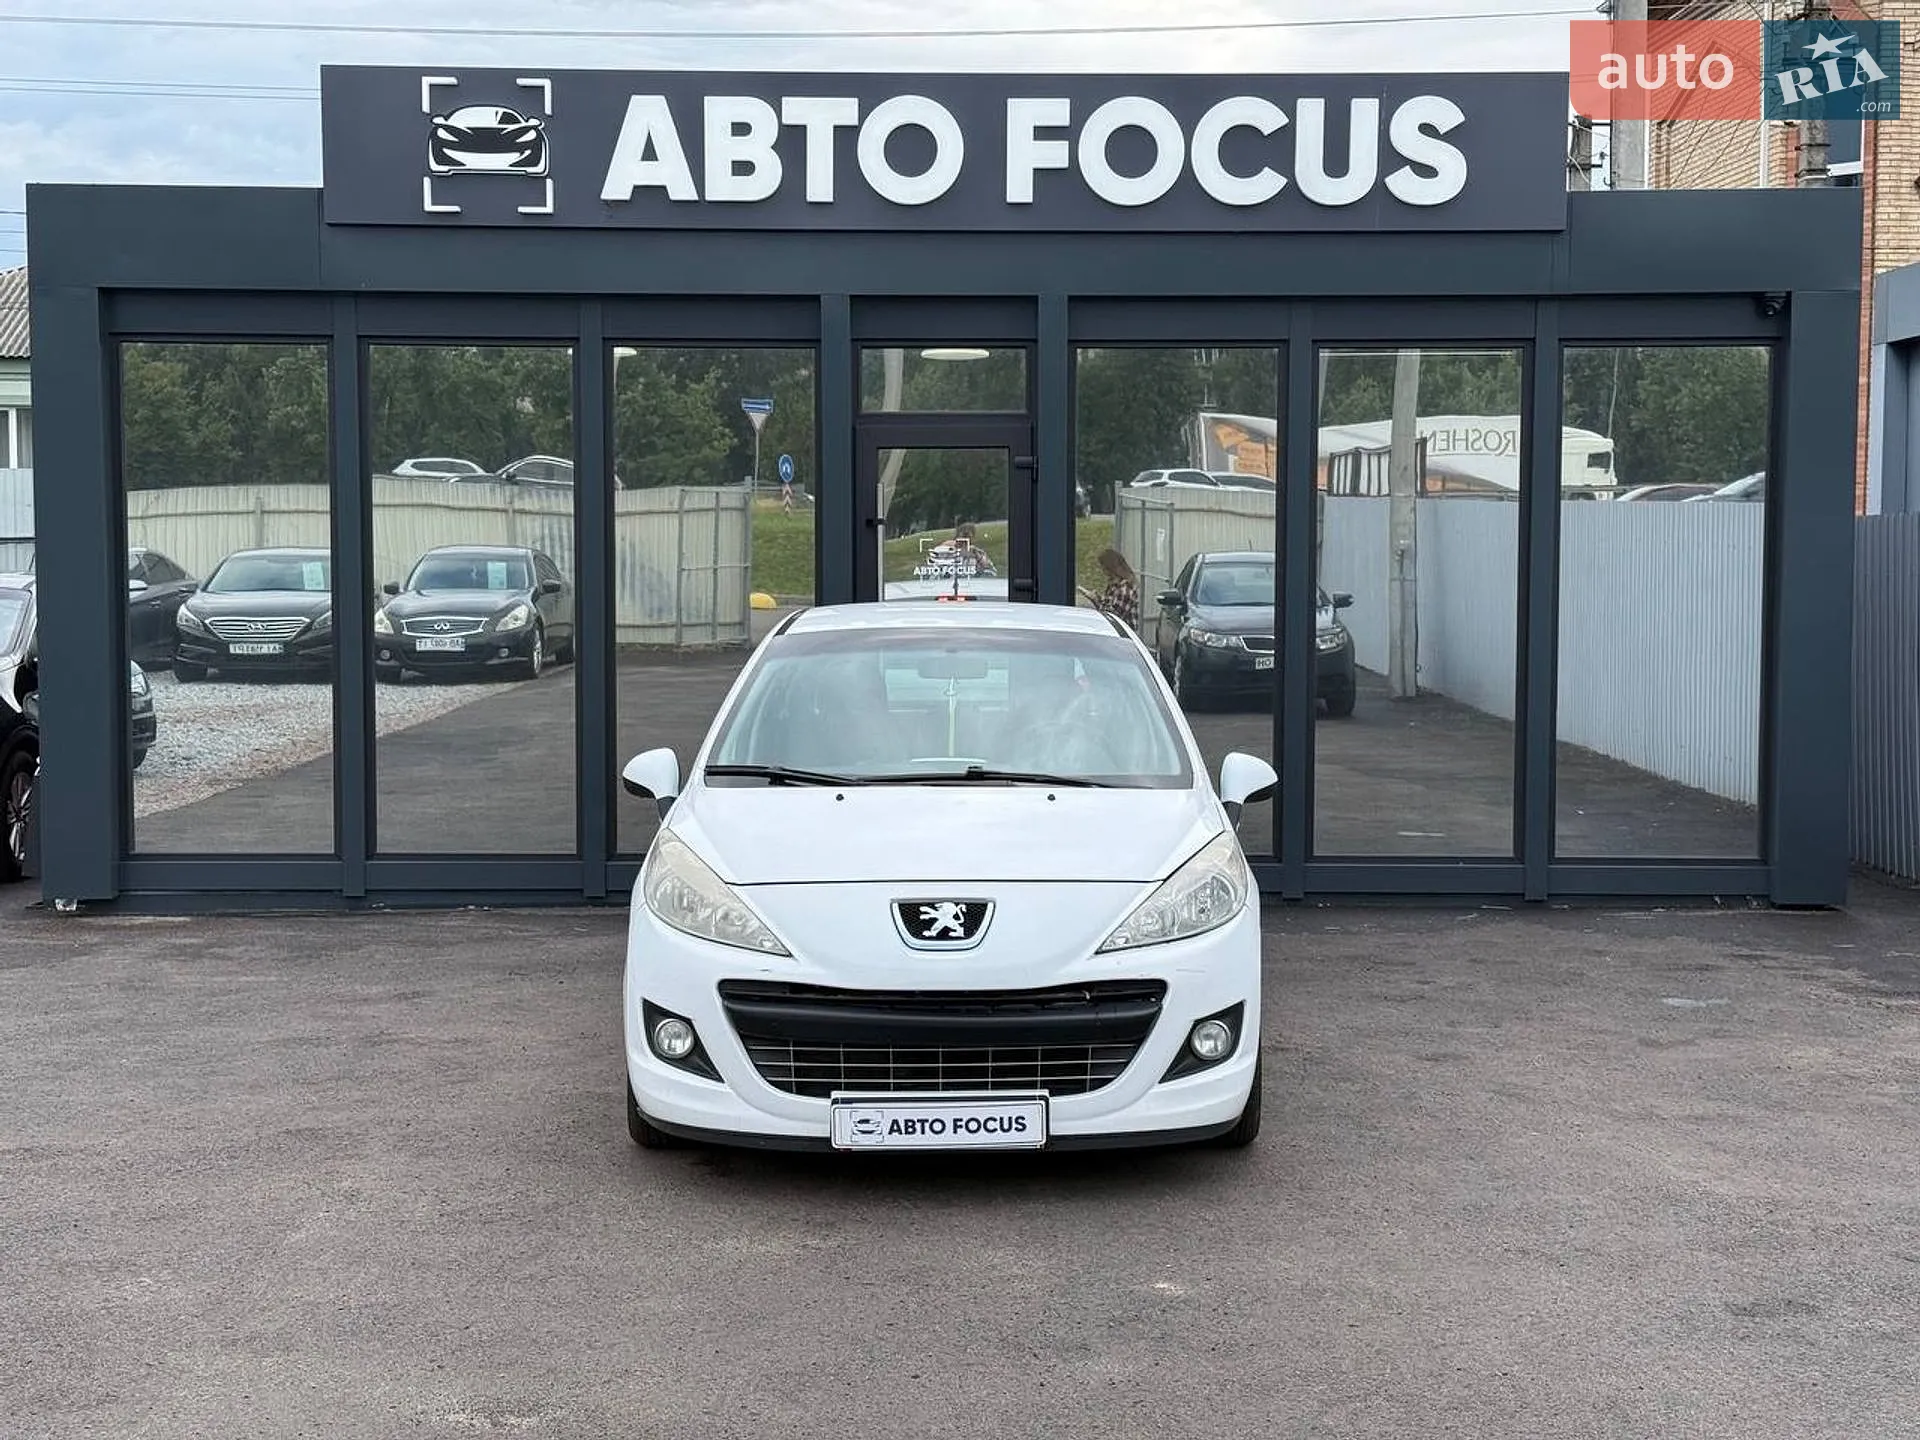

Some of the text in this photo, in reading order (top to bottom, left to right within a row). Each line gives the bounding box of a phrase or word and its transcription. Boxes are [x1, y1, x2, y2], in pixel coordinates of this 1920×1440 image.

[600, 94, 1468, 207] АВТО FOCUS
[941, 565, 977, 576] FOCUS
[952, 1115, 1028, 1135] FOCUS
